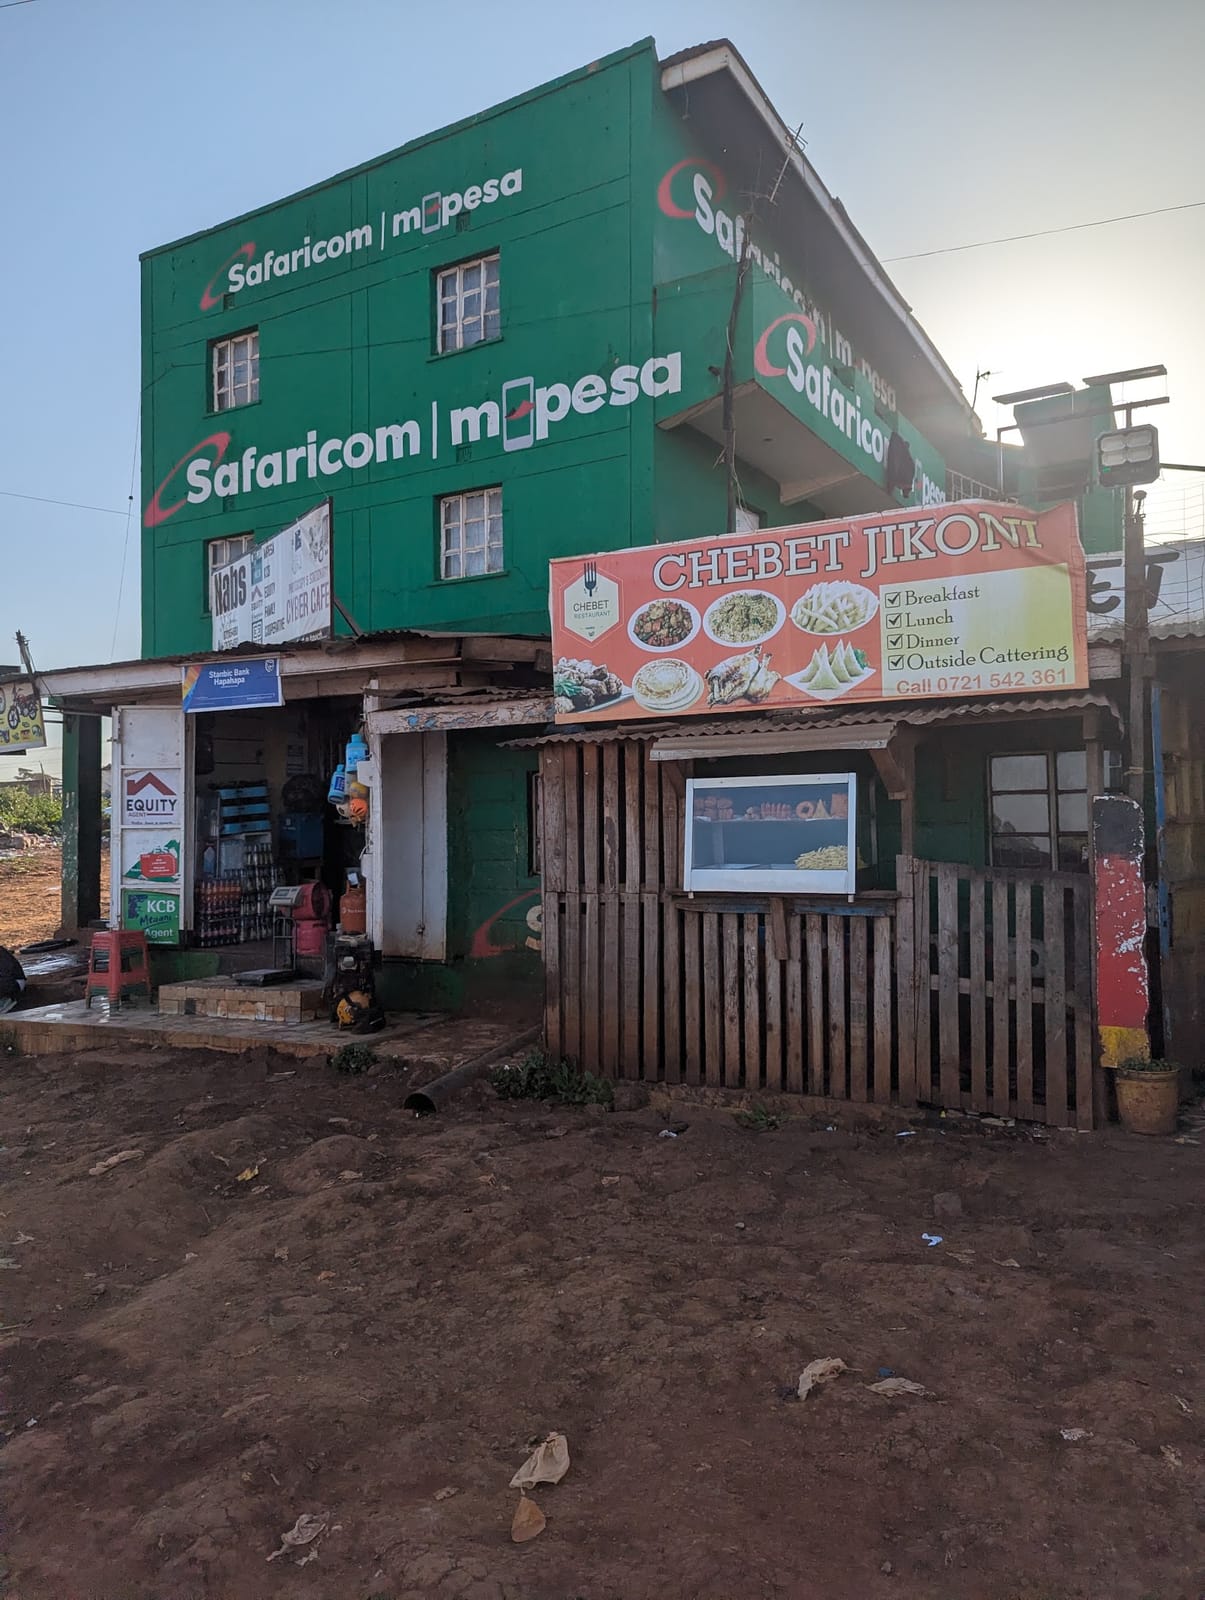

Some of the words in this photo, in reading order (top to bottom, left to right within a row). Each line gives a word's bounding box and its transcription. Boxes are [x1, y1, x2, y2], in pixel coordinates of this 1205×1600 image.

[228, 224, 372, 293] Safaricom
[786, 327, 889, 467] Safarico
[187, 420, 421, 503] Safaricom
[653, 530, 849, 592] CHEBET
[860, 512, 1043, 578] JIKONI
[905, 585, 980, 606] Breakfast
[573, 600, 609, 612] CHEBET
[573, 611, 611, 619] RESTAURANT
[905, 609, 953, 628] Lunch
[906, 633, 960, 650] Dinner
[906, 648, 977, 671] Outside
[979, 645, 1069, 665] Cattering
[209, 670, 233, 679] Stanbic
[234, 668, 250, 677] Bank
[213, 677, 246, 686] Hapahapa
[896, 680, 932, 695] Call
[937, 673, 983, 692] 0721
[989, 671, 1026, 689] 542
[1032, 667, 1067, 685] 361
[127, 799, 177, 811] EQUITY
[147, 900, 176, 913] KCB
[144, 928, 173, 939] Agent
